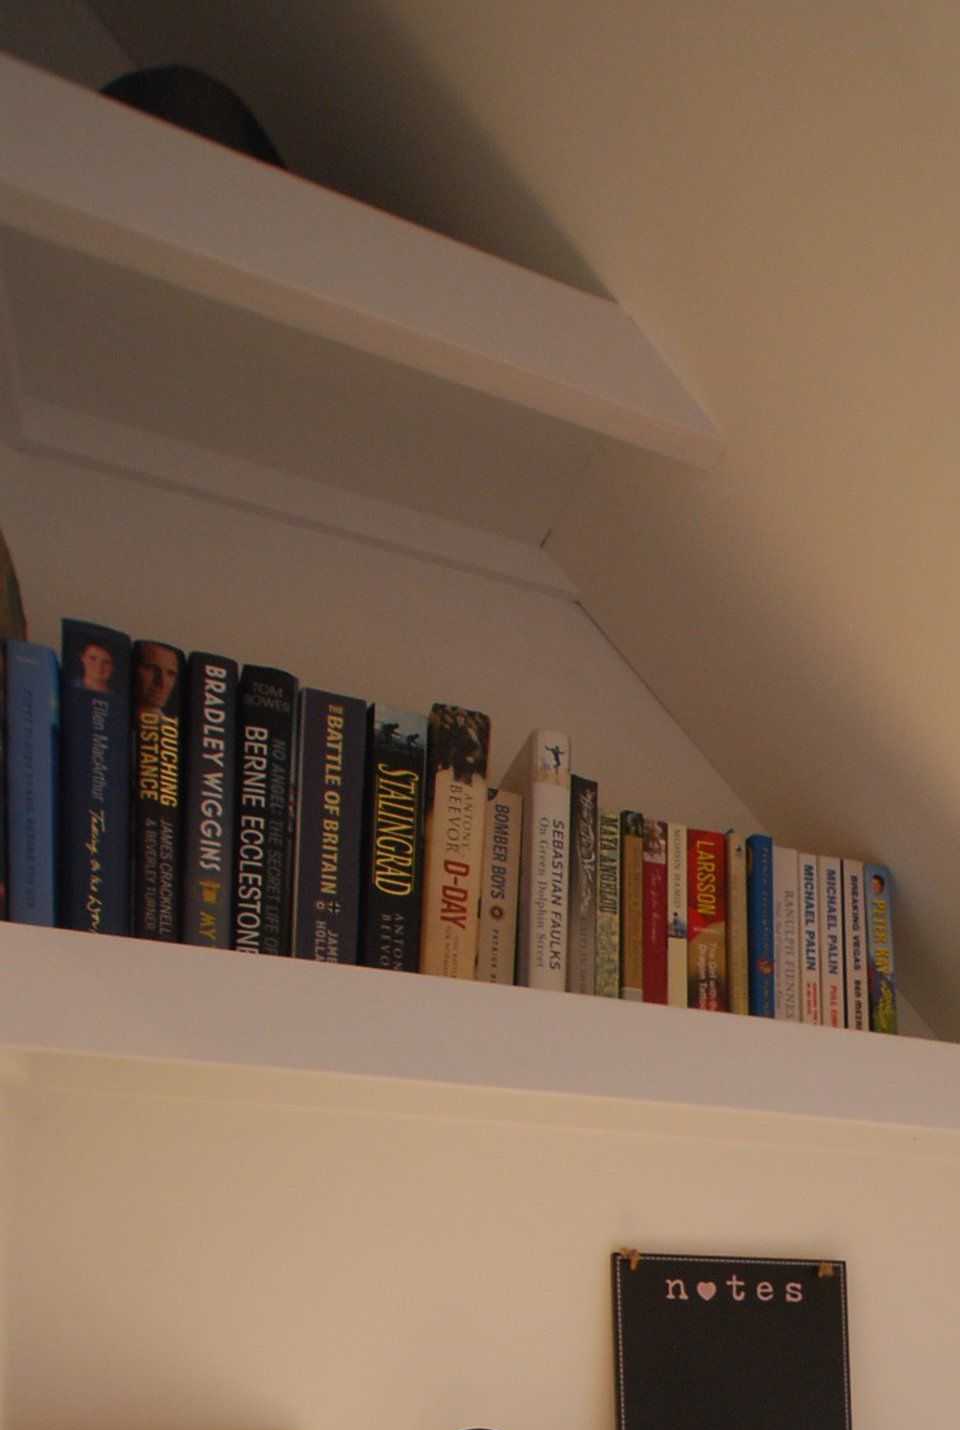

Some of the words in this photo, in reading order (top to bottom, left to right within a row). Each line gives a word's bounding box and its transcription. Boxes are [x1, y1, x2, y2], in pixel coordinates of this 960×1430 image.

[92, 699, 109, 731] Ellen
[202, 665, 228, 768] BRADLEY
[91, 732, 109, 801] MacArthur
[139, 711, 160, 801] DISTANCE
[159, 715, 180, 808] TOUCHING
[241, 724, 269, 809] BERNIE
[272, 740, 287, 761] NO
[324, 715, 345, 786] BATTLE
[200, 771, 224, 873] WIGGINS
[322, 790, 342, 817] OF
[374, 762, 420, 896] STALINGRAD
[446, 784, 463, 853] BEEVOR
[460, 793, 473, 850] ANTONY
[539, 818, 549, 835] On
[144, 829, 158, 884] BEVERLEY
[159, 819, 173, 860] JAMES
[267, 820, 285, 846] THE
[319, 817, 341, 896] BRITAIN
[492, 803, 510, 862] BOMBER
[539, 840, 549, 876] Green
[600, 816, 619, 852] MAYA
[673, 829, 682, 870] MOHSIN
[265, 849, 283, 901] SECRET
[490, 864, 507, 899] BOYS
[551, 819, 565, 906] SEBASTIAN
[599, 855, 618, 915] ANGELOU
[696, 840, 716, 916] LARSSON
[144, 886, 157, 931] TURNER
[159, 862, 173, 934] CRACKNELL
[264, 904, 281, 934] LIFE
[440, 859, 470, 930] D-DAY
[534, 881, 549, 928] Dolphin
[673, 873, 682, 909] HAMID
[803, 865, 816, 926] MICHAEL
[826, 869, 838, 930] MICHAEL
[851, 875, 860, 931] BREAKING
[549, 910, 562, 970] FAULKS
[784, 891, 795, 956] RANULPH
[872, 899, 888, 944] PETER
[535, 933, 547, 969] Street
[806, 930, 817, 971] PALIN
[828, 934, 839, 974] PALIN
[854, 934, 862, 971] VEGAS
[874, 946, 892, 974] KAY
[784, 960, 796, 1018] FIENNES
